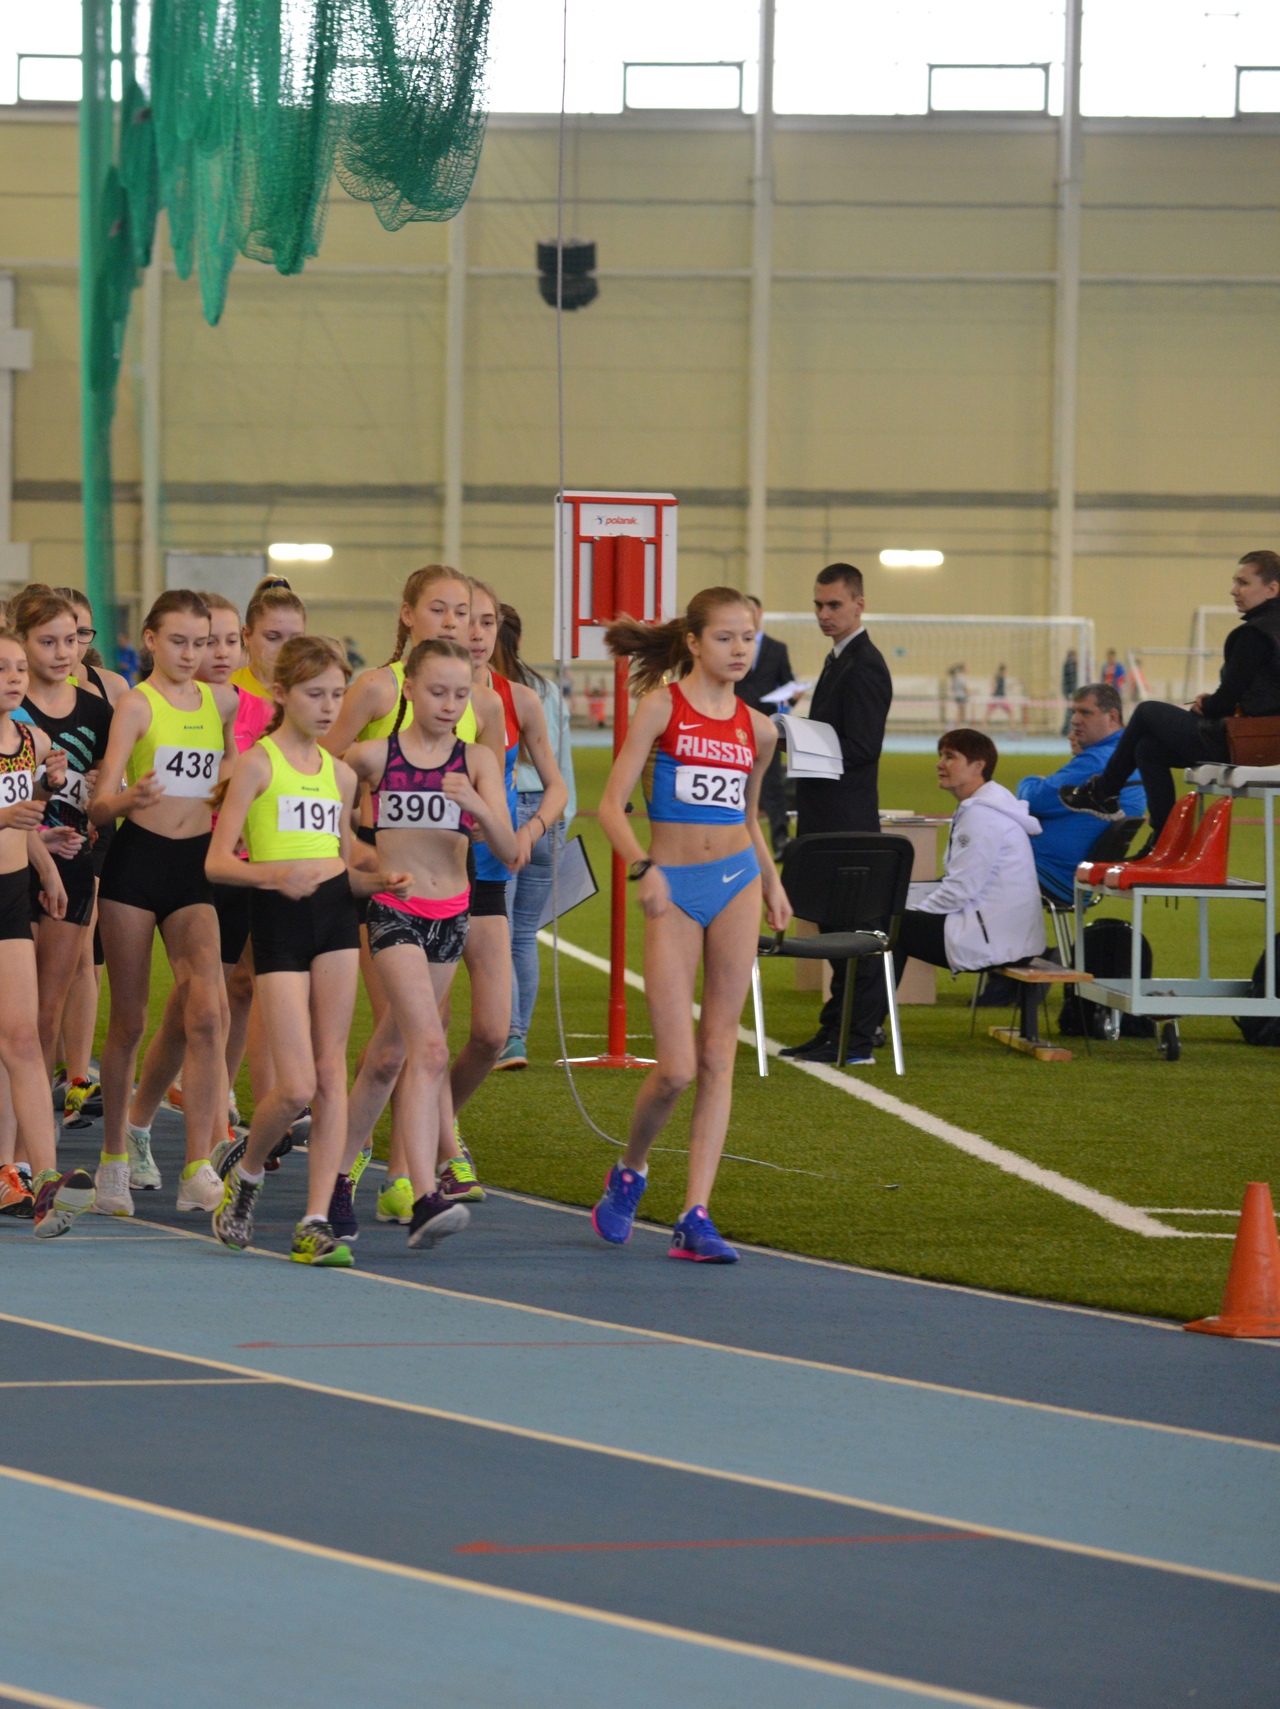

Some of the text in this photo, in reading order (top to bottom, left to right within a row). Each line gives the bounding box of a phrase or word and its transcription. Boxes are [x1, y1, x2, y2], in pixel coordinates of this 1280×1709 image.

[605, 516, 637, 526] polanik
[166, 751, 214, 779] 438
[675, 734, 754, 769] RUSSIA
[691, 774, 740, 805] 523
[294, 801, 335, 832] 191
[387, 794, 445, 822] 390
